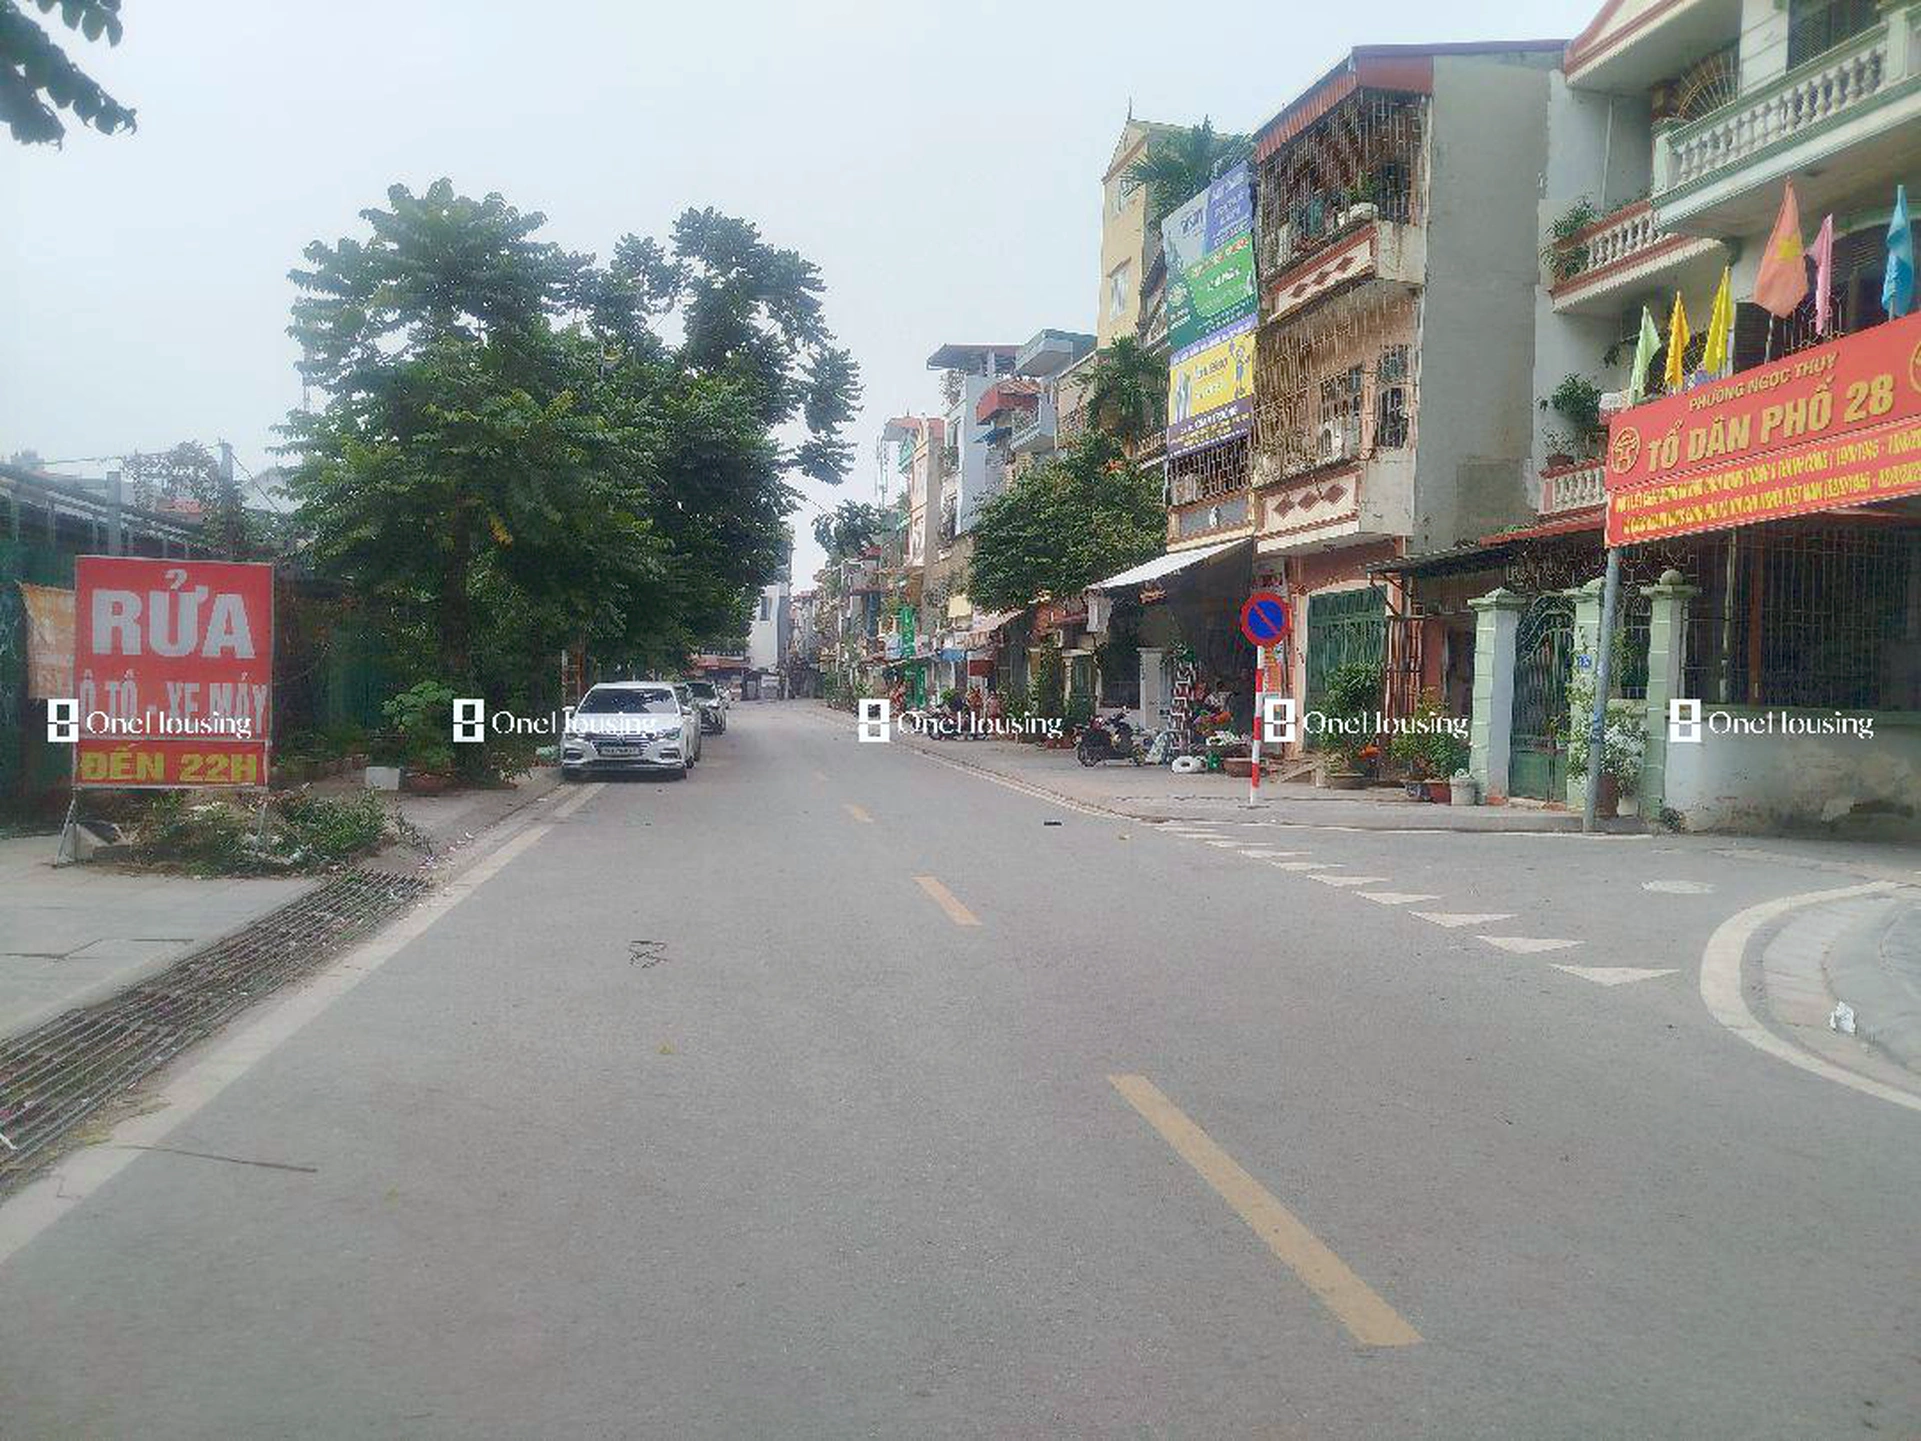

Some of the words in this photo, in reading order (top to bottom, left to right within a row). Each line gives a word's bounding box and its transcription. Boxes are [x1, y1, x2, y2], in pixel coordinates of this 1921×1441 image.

[1688, 413, 1750, 463] DÂN
[1760, 376, 1837, 444] PHỐ
[1843, 374, 1894, 423] 28
[92, 568, 256, 659] RỬA
[80, 743, 165, 781] ĐẾN
[179, 752, 257, 783] 22H
